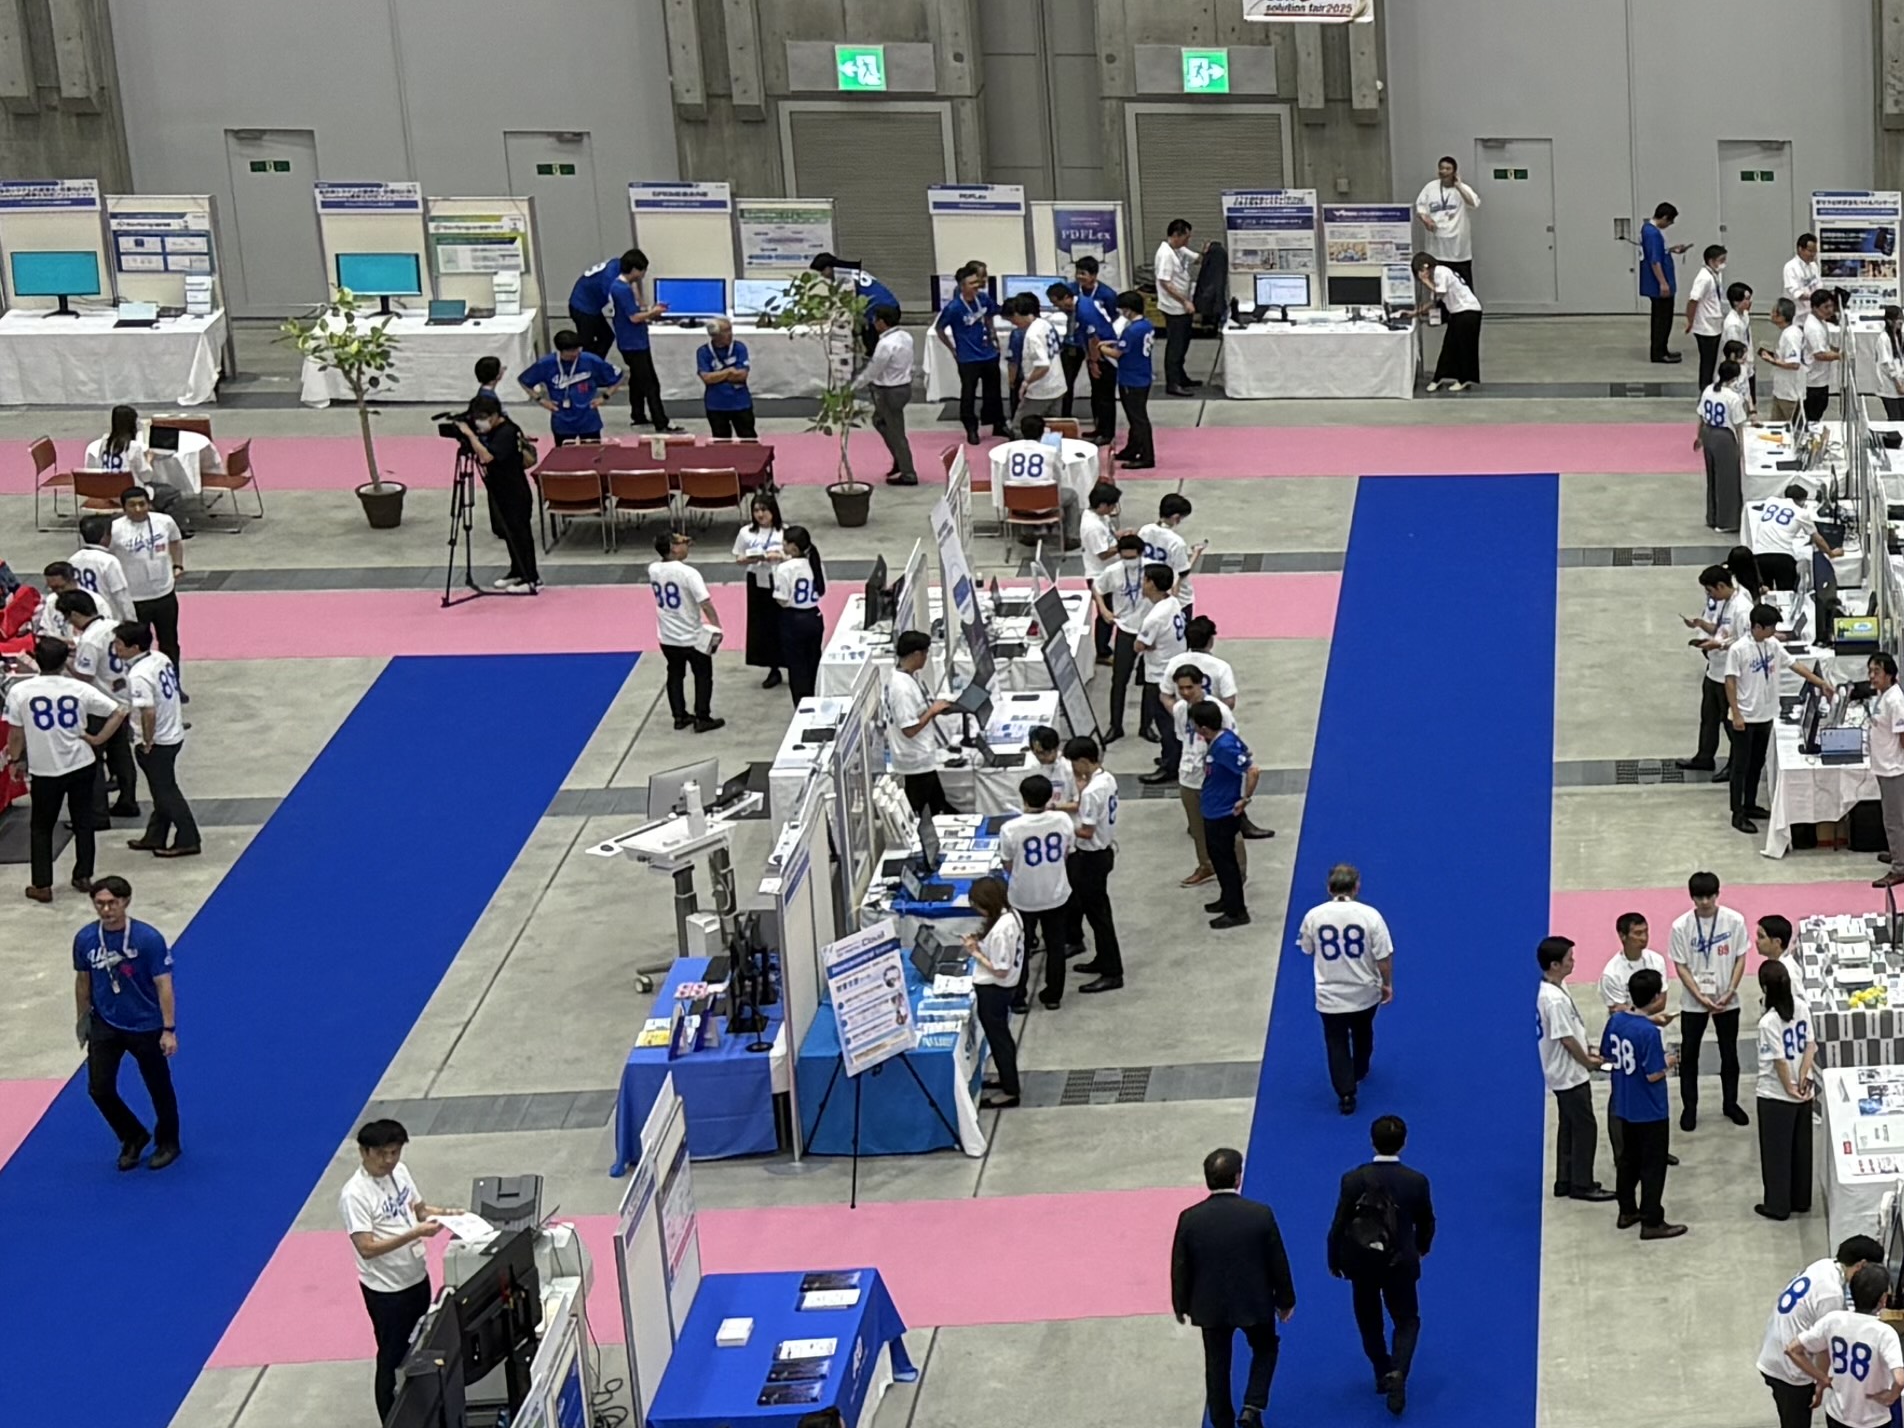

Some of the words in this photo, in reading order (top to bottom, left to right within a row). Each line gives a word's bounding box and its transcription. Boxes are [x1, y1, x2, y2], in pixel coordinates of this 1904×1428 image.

[1704, 401, 1727, 428] 88
[1010, 452, 1044, 477] 88
[1760, 502, 1796, 528] 88
[652, 581, 681, 611] 88
[31, 695, 79, 730] 88
[1022, 831, 1064, 867] 88
[1318, 923, 1365, 961] 88
[1829, 1335, 1872, 1382] 88
